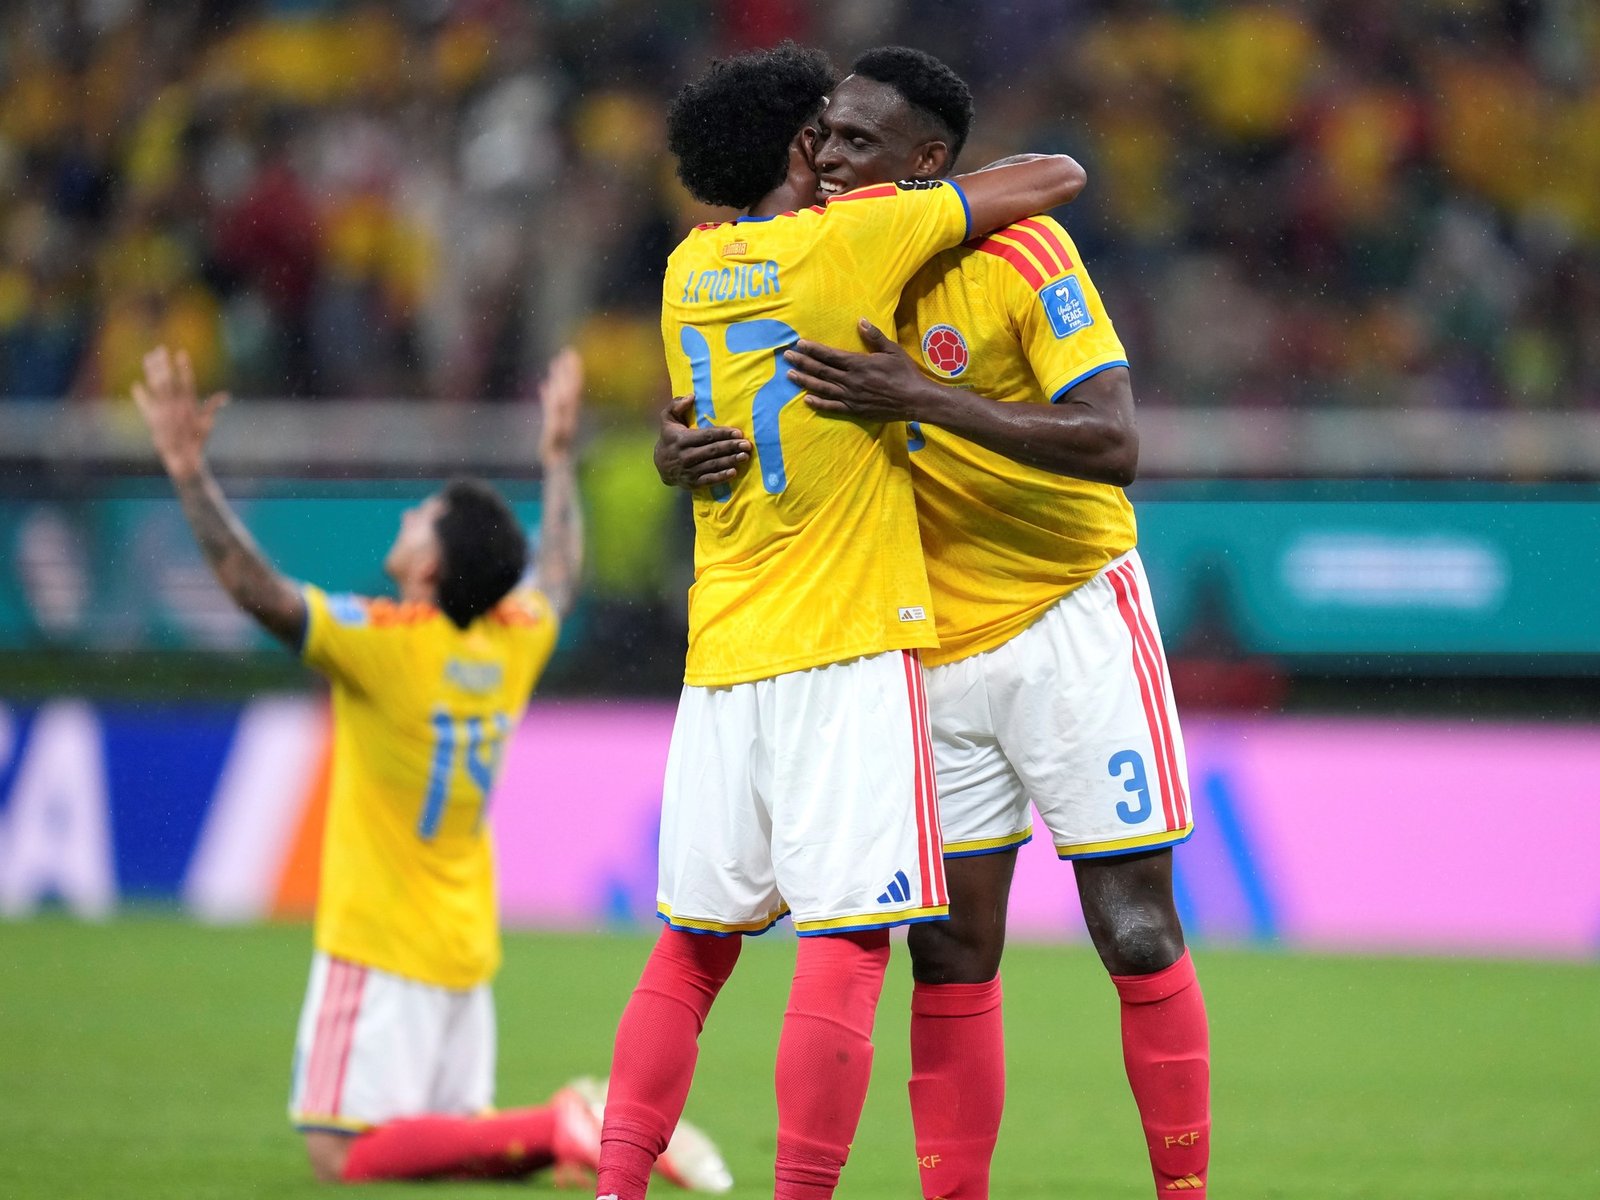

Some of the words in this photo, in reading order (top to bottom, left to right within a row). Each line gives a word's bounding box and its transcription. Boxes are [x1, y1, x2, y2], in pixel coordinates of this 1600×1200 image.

[1062, 307, 1084, 325] PEACE
[680, 318, 804, 503] 17
[1108, 749, 1152, 824] 3
[1164, 1131, 1200, 1149] FCF
